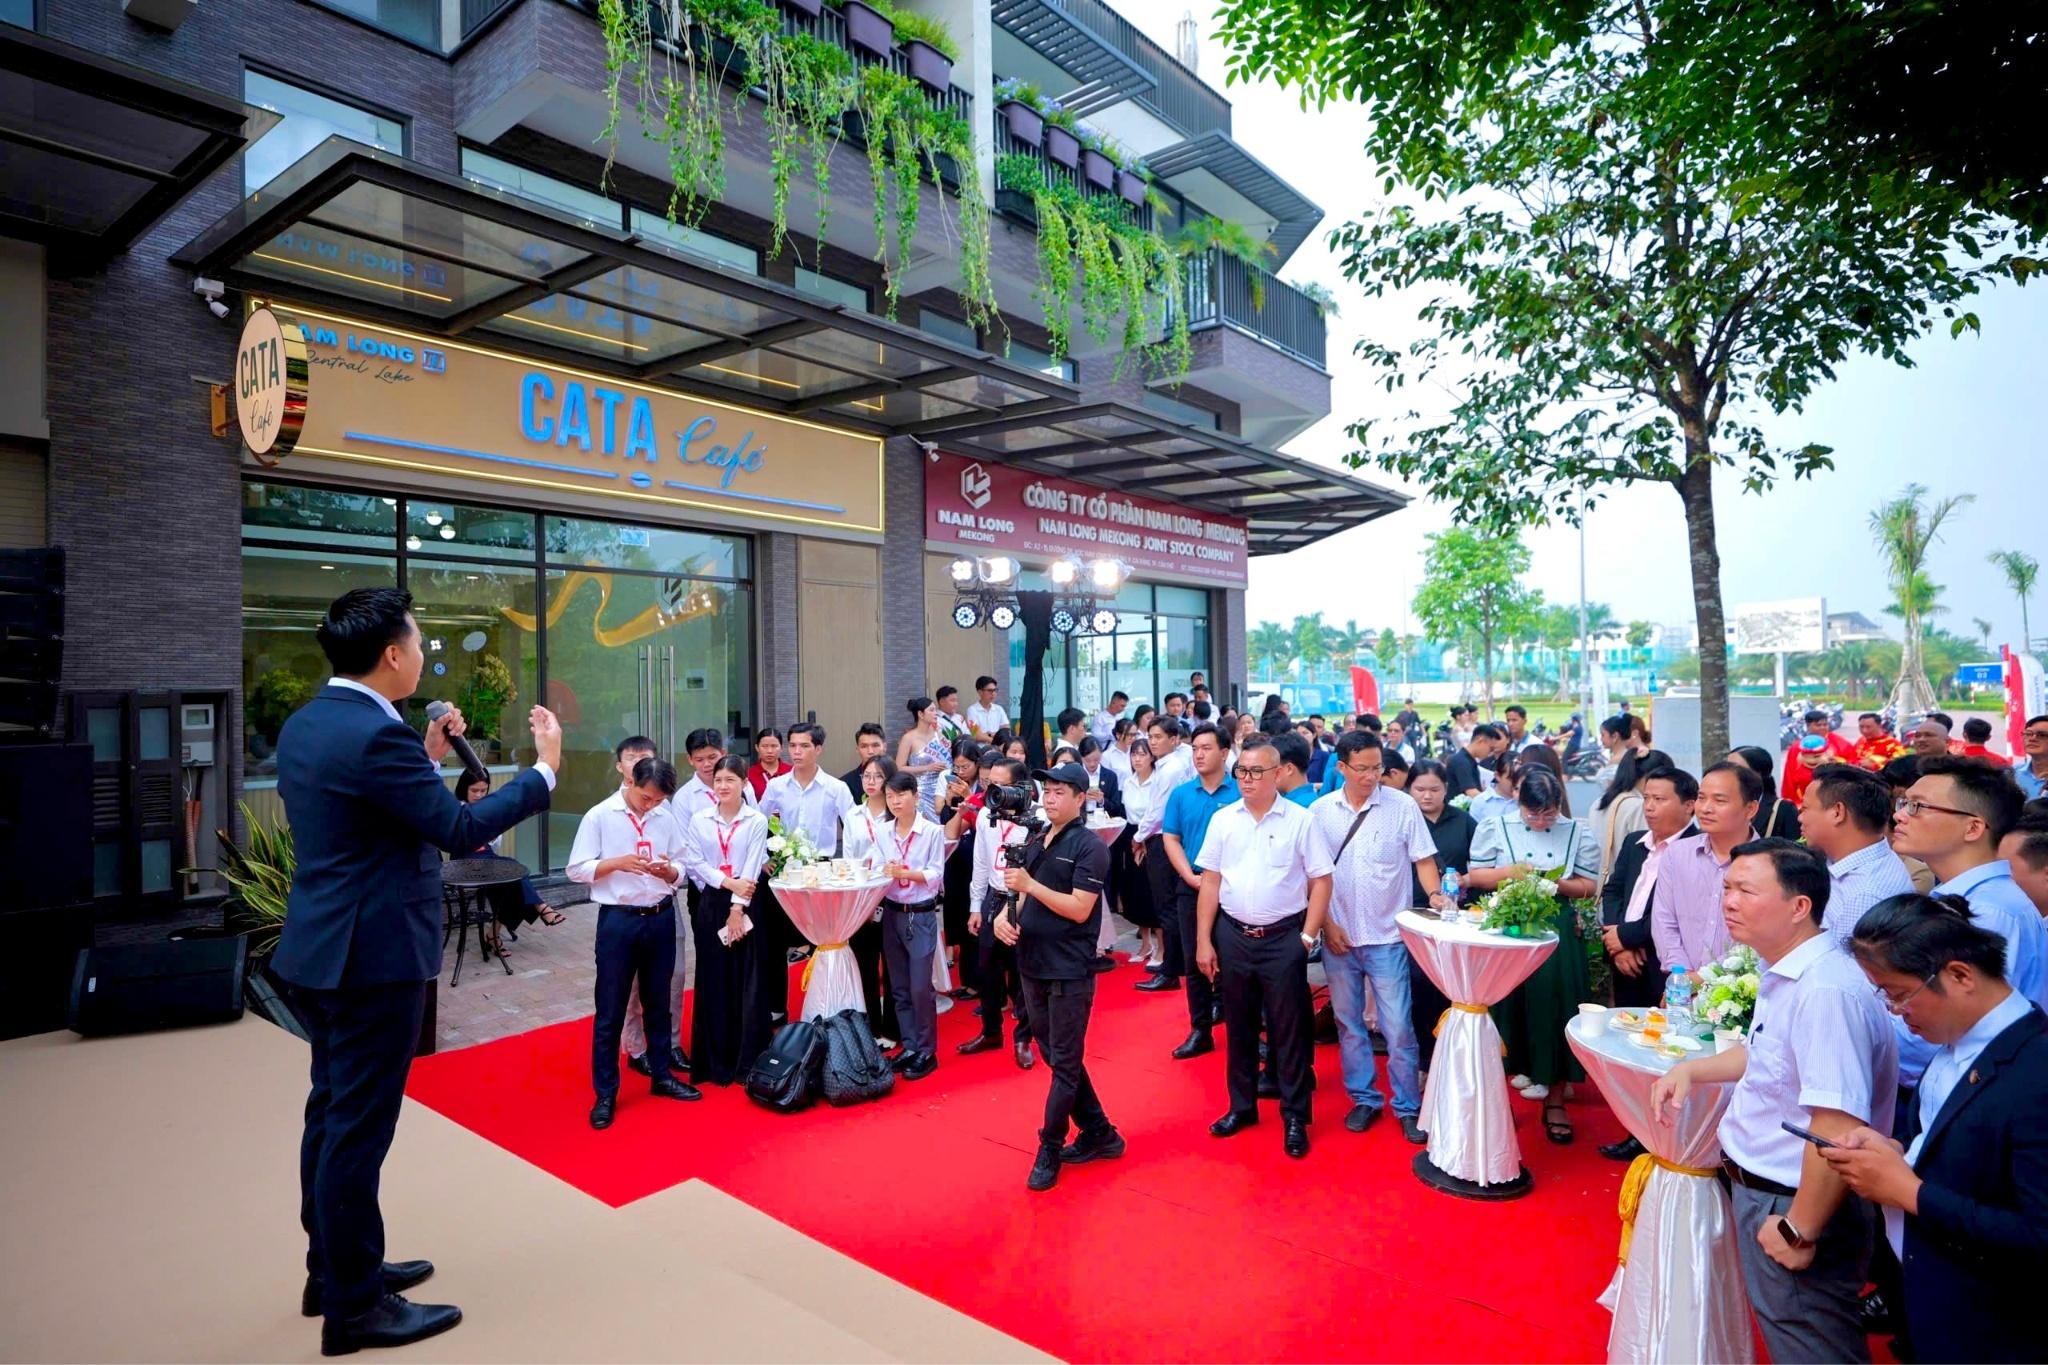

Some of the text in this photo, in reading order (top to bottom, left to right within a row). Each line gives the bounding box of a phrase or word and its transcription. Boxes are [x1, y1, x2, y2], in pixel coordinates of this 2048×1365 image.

[298, 323, 338, 347] AM
[347, 335, 416, 363] LONG
[240, 337, 280, 399] CATA
[375, 365, 416, 384] Lake
[249, 400, 273, 442] Café
[519, 370, 770, 489] CATA Café
[937, 509, 1015, 533] NAM LONG
[1023, 481, 1068, 512] CÔNG
[1069, 493, 1088, 516] TY
[1143, 509, 1172, 532] NAM
[1172, 515, 1203, 538] LONG
[1203, 521, 1246, 545] MEKONG
[957, 530, 995, 543] MEKONG
[1039, 518, 1067, 536] NAM
[1069, 522, 1097, 540] LONG
[1098, 528, 1140, 548] MEKONG
[1143, 536, 1168, 553] JOINT
[1169, 540, 1196, 557] STOCK
[1196, 545, 1235, 562] COMPANY
